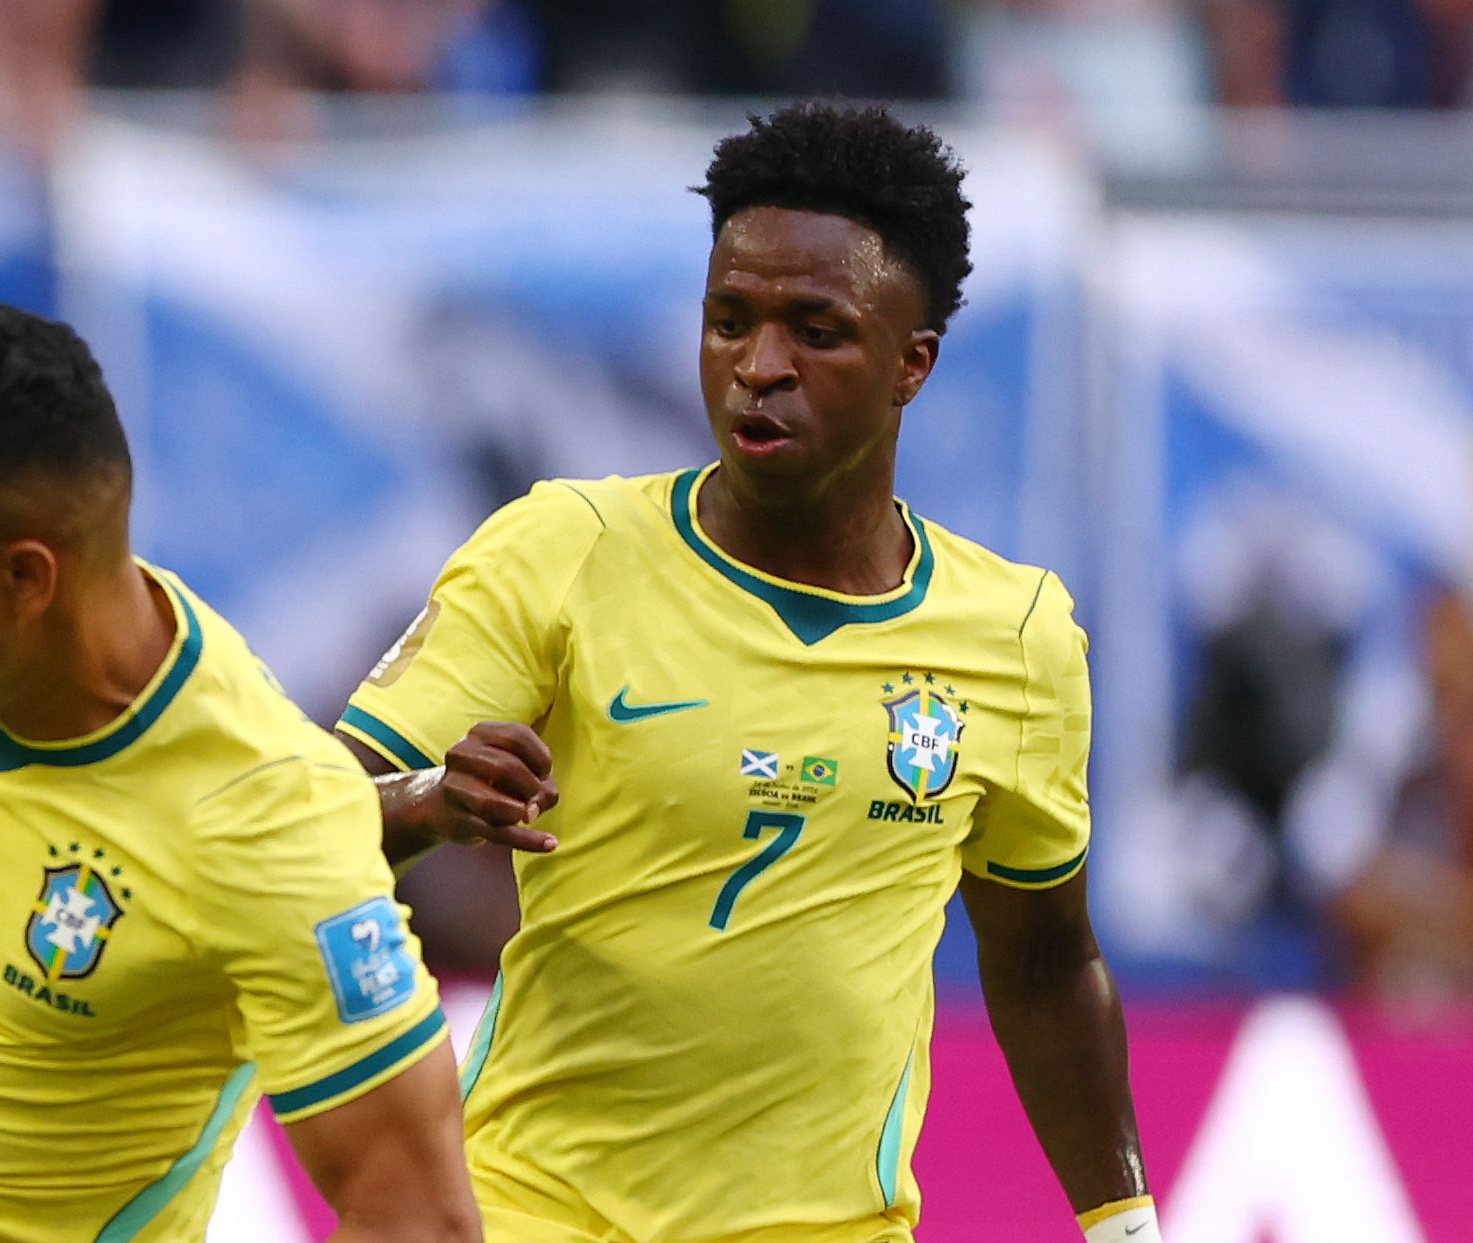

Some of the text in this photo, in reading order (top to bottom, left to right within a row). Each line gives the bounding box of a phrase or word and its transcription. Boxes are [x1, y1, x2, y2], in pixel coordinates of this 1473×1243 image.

[911, 733, 939, 750] CBF
[867, 800, 943, 824] BRASIL
[708, 809, 806, 932] 7
[2, 963, 95, 1018] BRASIL
